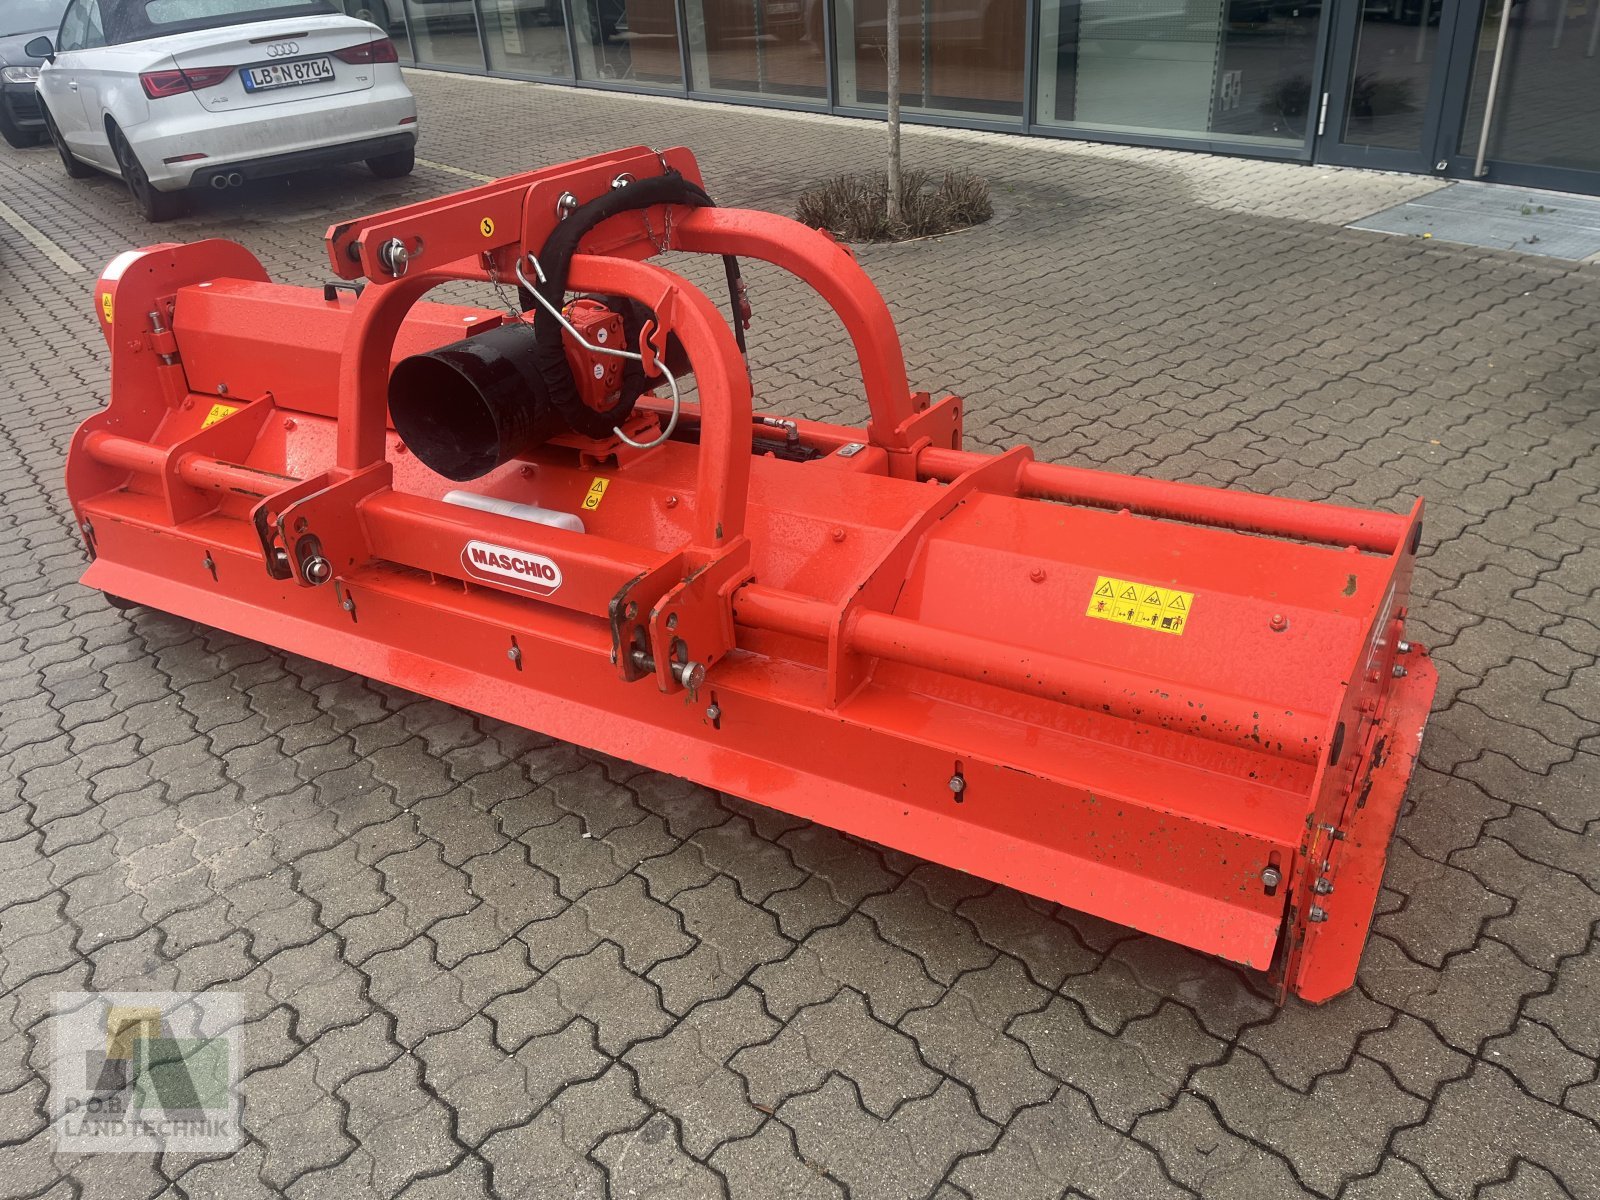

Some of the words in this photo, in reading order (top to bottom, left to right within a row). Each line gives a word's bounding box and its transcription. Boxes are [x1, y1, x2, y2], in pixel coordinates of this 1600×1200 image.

[251, 69, 273, 86] LB
[280, 66, 293, 81] N
[294, 60, 330, 79] 8704
[211, 97, 229, 105] A3
[471, 547, 555, 581] MASCHIO
